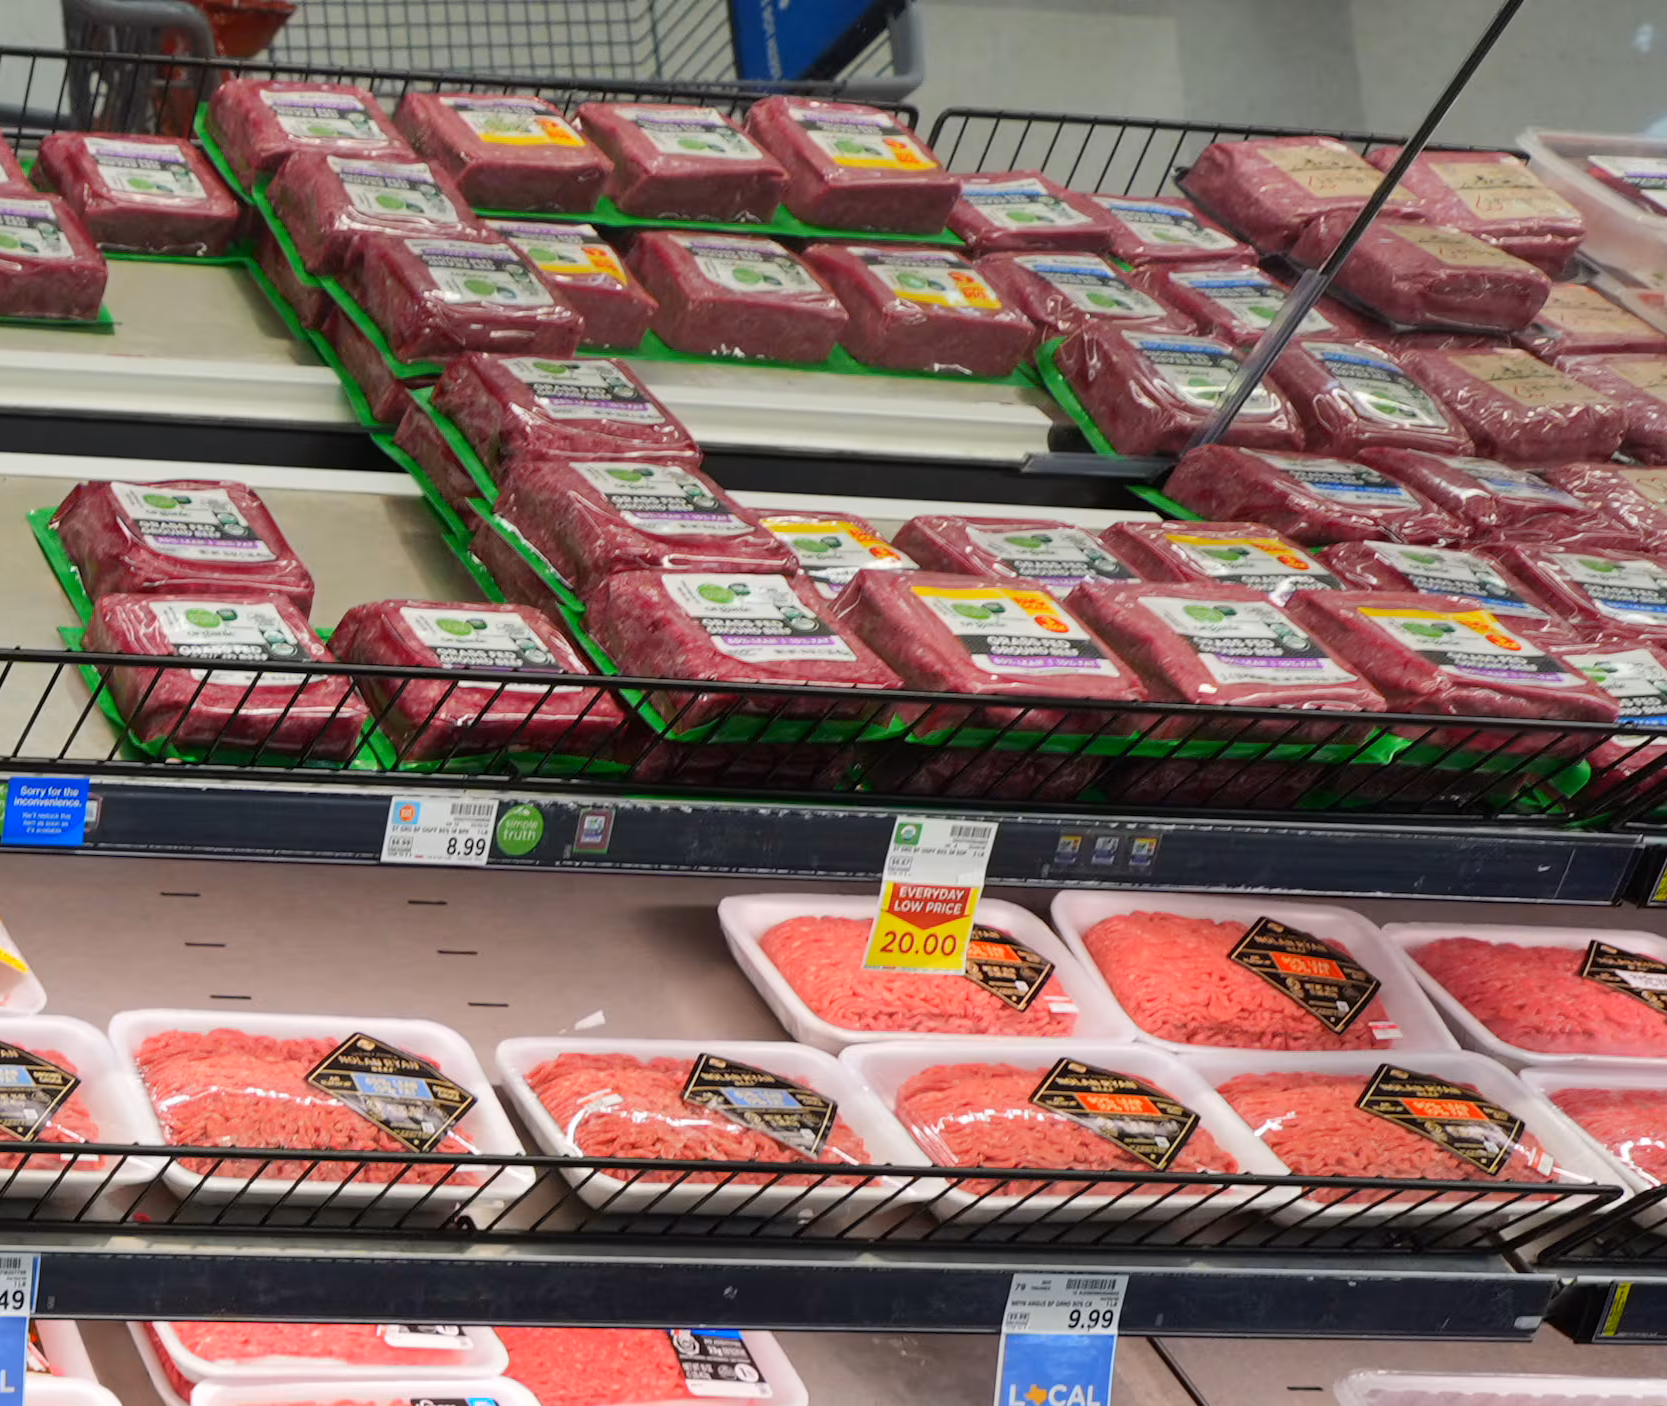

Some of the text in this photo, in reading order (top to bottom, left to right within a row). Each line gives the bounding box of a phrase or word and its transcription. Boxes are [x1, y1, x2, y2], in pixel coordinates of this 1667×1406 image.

[19, 786, 79, 798] Sorry for the
[506, 819, 538, 830] simple
[503, 829, 537, 842] truth
[446, 838, 486, 856] 8.99
[898, 886, 965, 901] EVERYDAY
[893, 900, 964, 915] LOW PRICE
[880, 931, 957, 956] 20.00
[1067, 1308, 1114, 1329] 9.99
